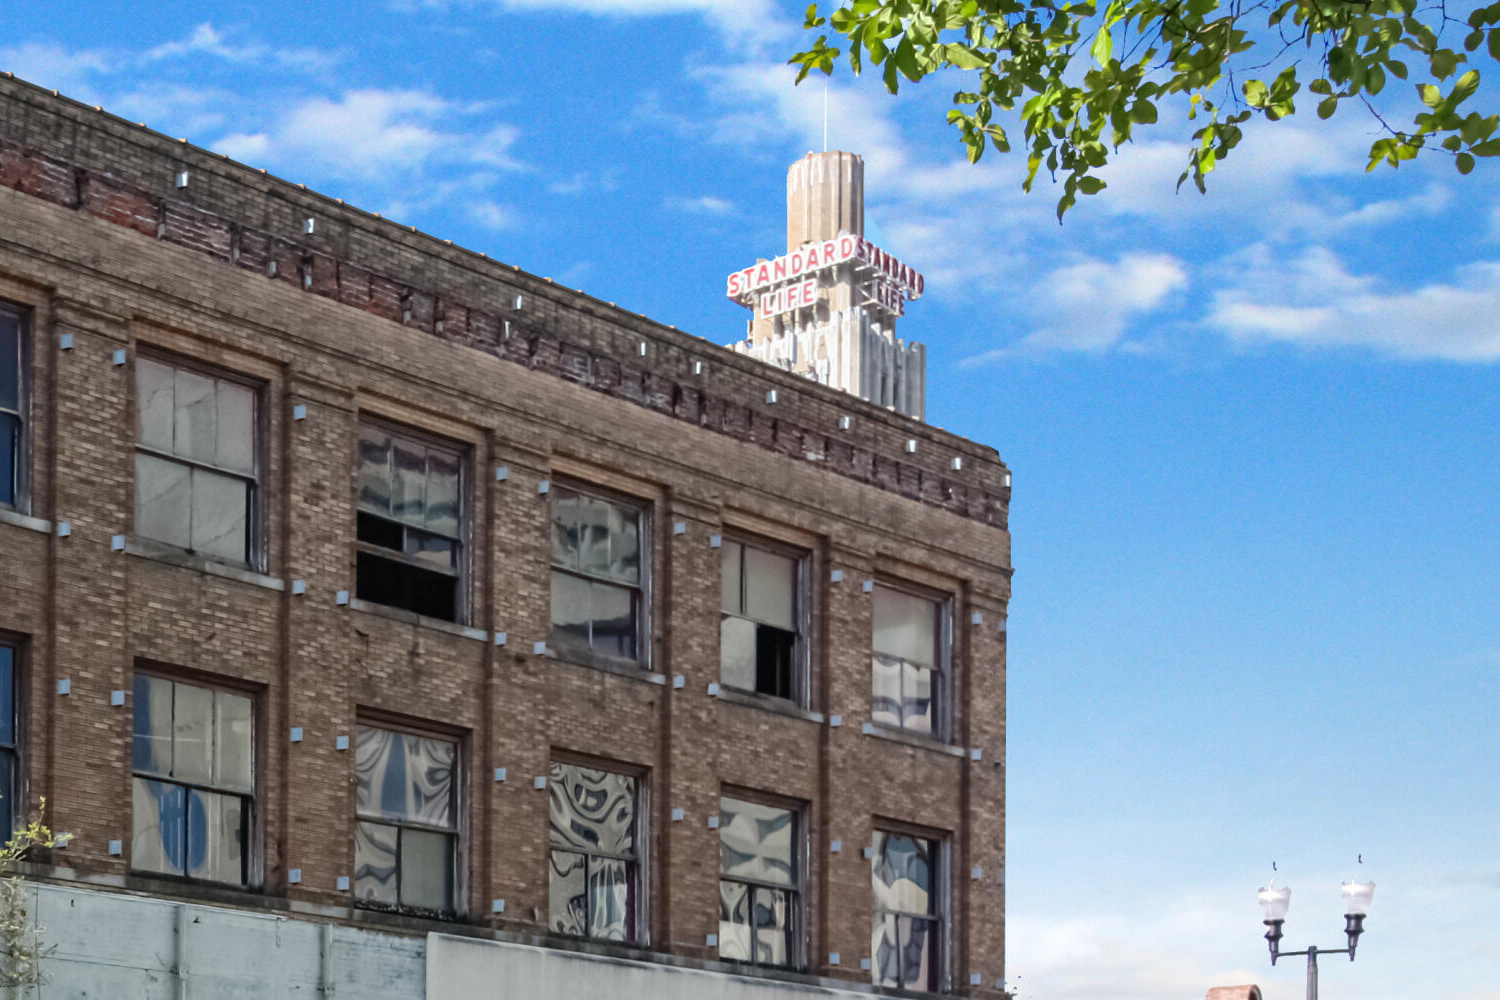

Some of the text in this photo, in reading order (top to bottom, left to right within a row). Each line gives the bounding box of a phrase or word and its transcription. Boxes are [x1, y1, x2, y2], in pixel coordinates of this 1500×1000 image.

[729, 238, 853, 295] STANDARD
[857, 237, 925, 295] STANDARD
[763, 282, 814, 316] LIFE
[877, 282, 905, 316] LIFE
